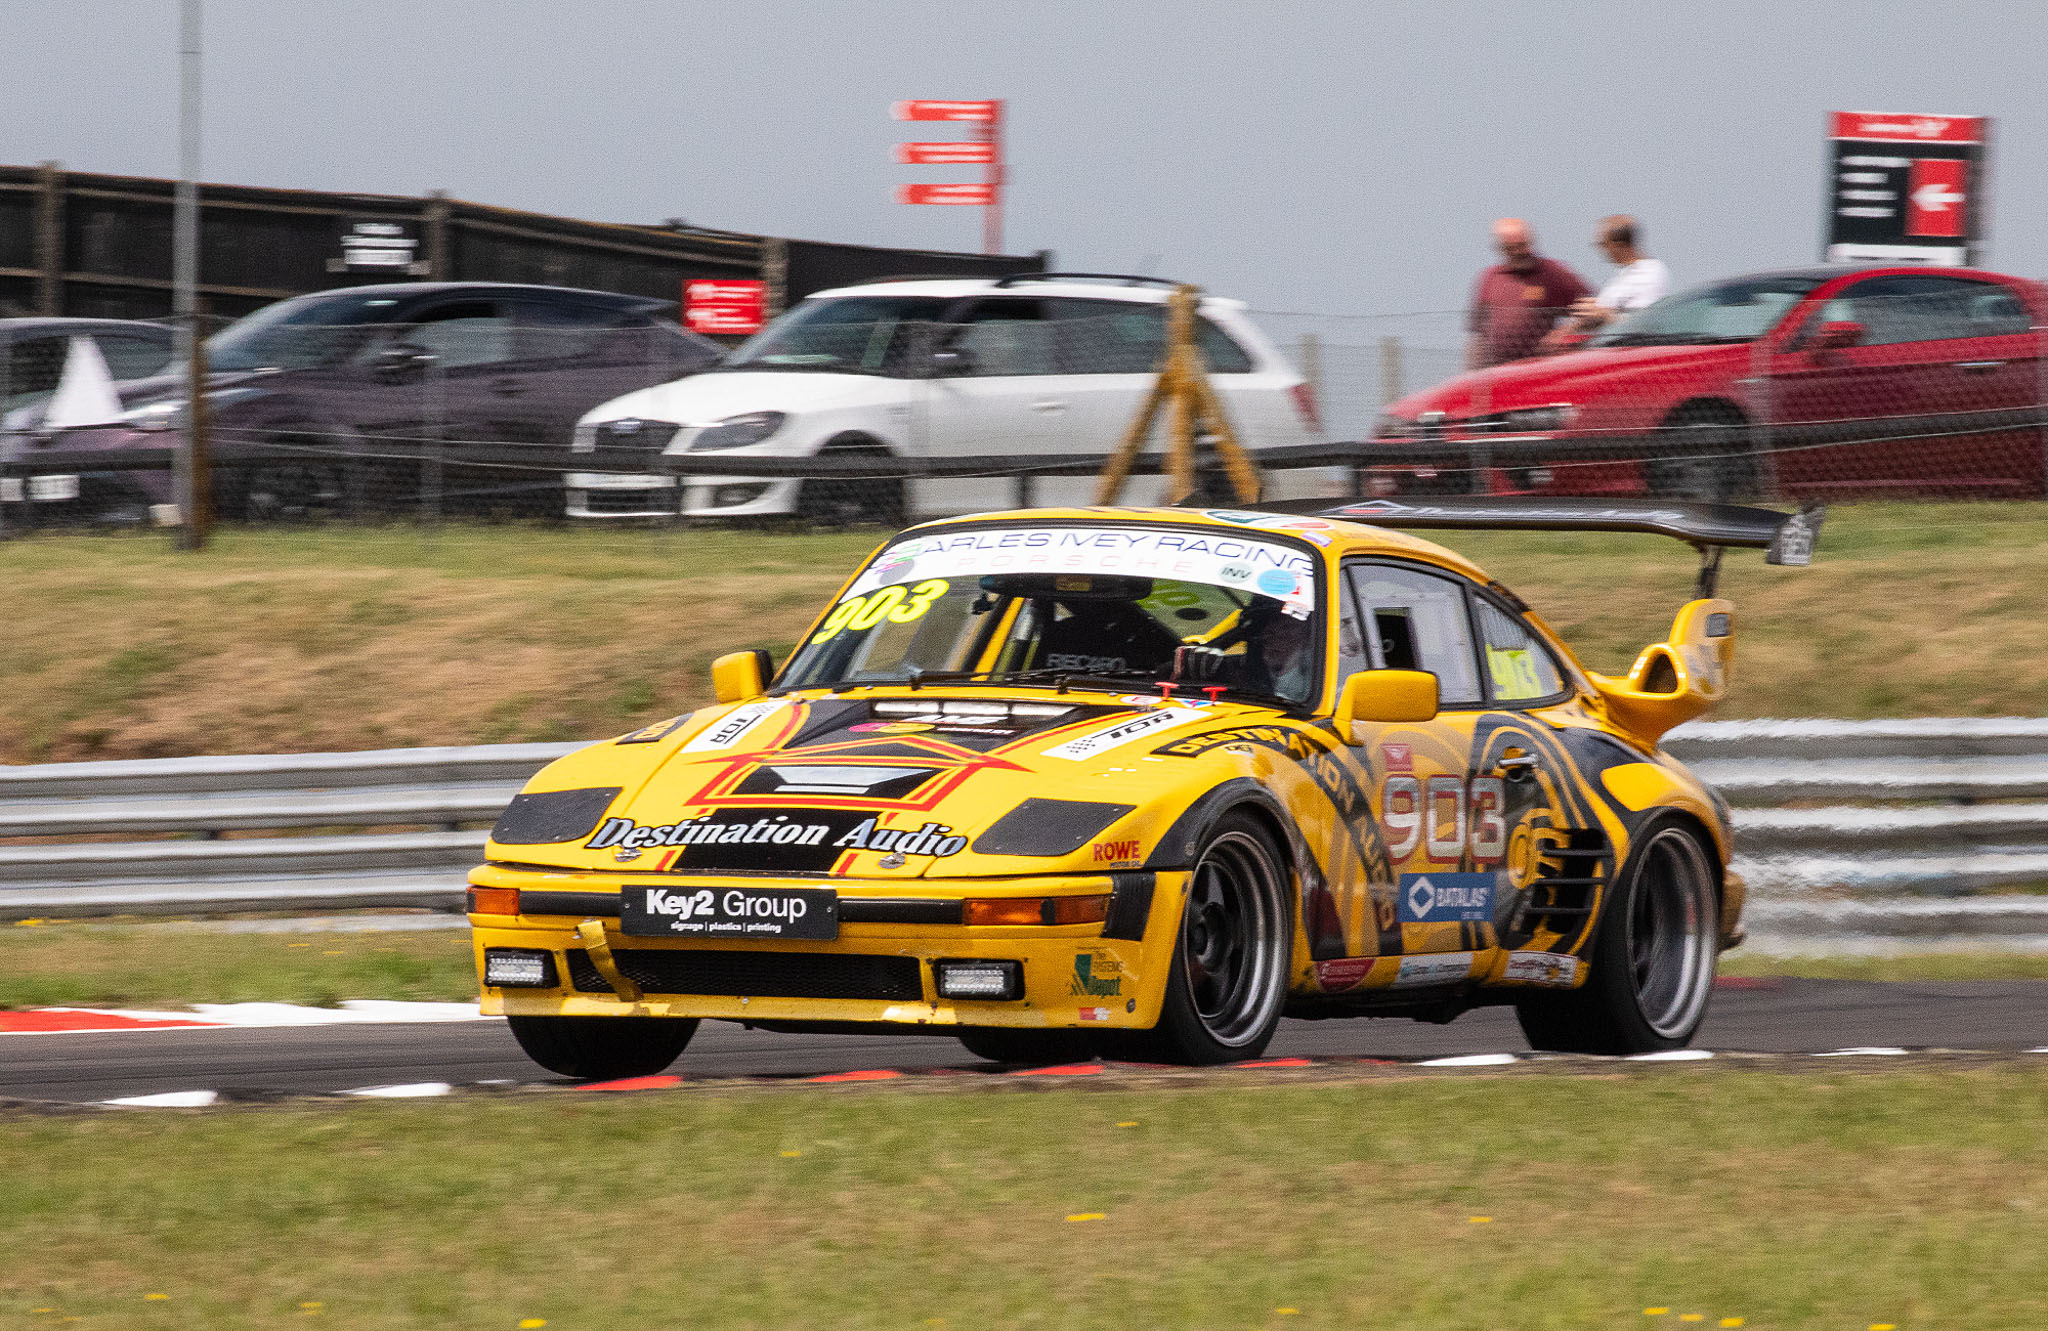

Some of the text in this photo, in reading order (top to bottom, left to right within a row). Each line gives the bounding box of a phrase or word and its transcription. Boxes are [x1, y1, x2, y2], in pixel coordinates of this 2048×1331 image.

[956, 555, 1194, 573] PORSCHE
[1060, 532, 1150, 548] IVEY
[1155, 536, 1313, 577] RACING
[1221, 567, 1251, 579] INV
[811, 578, 950, 645] 903
[585, 815, 970, 857] Destination Audio
[1381, 774, 1505, 865] 903
[1093, 840, 1140, 862] ROWE
[646, 889, 807, 923] Key2 Group
[670, 921, 782, 934] signage plastics printing
